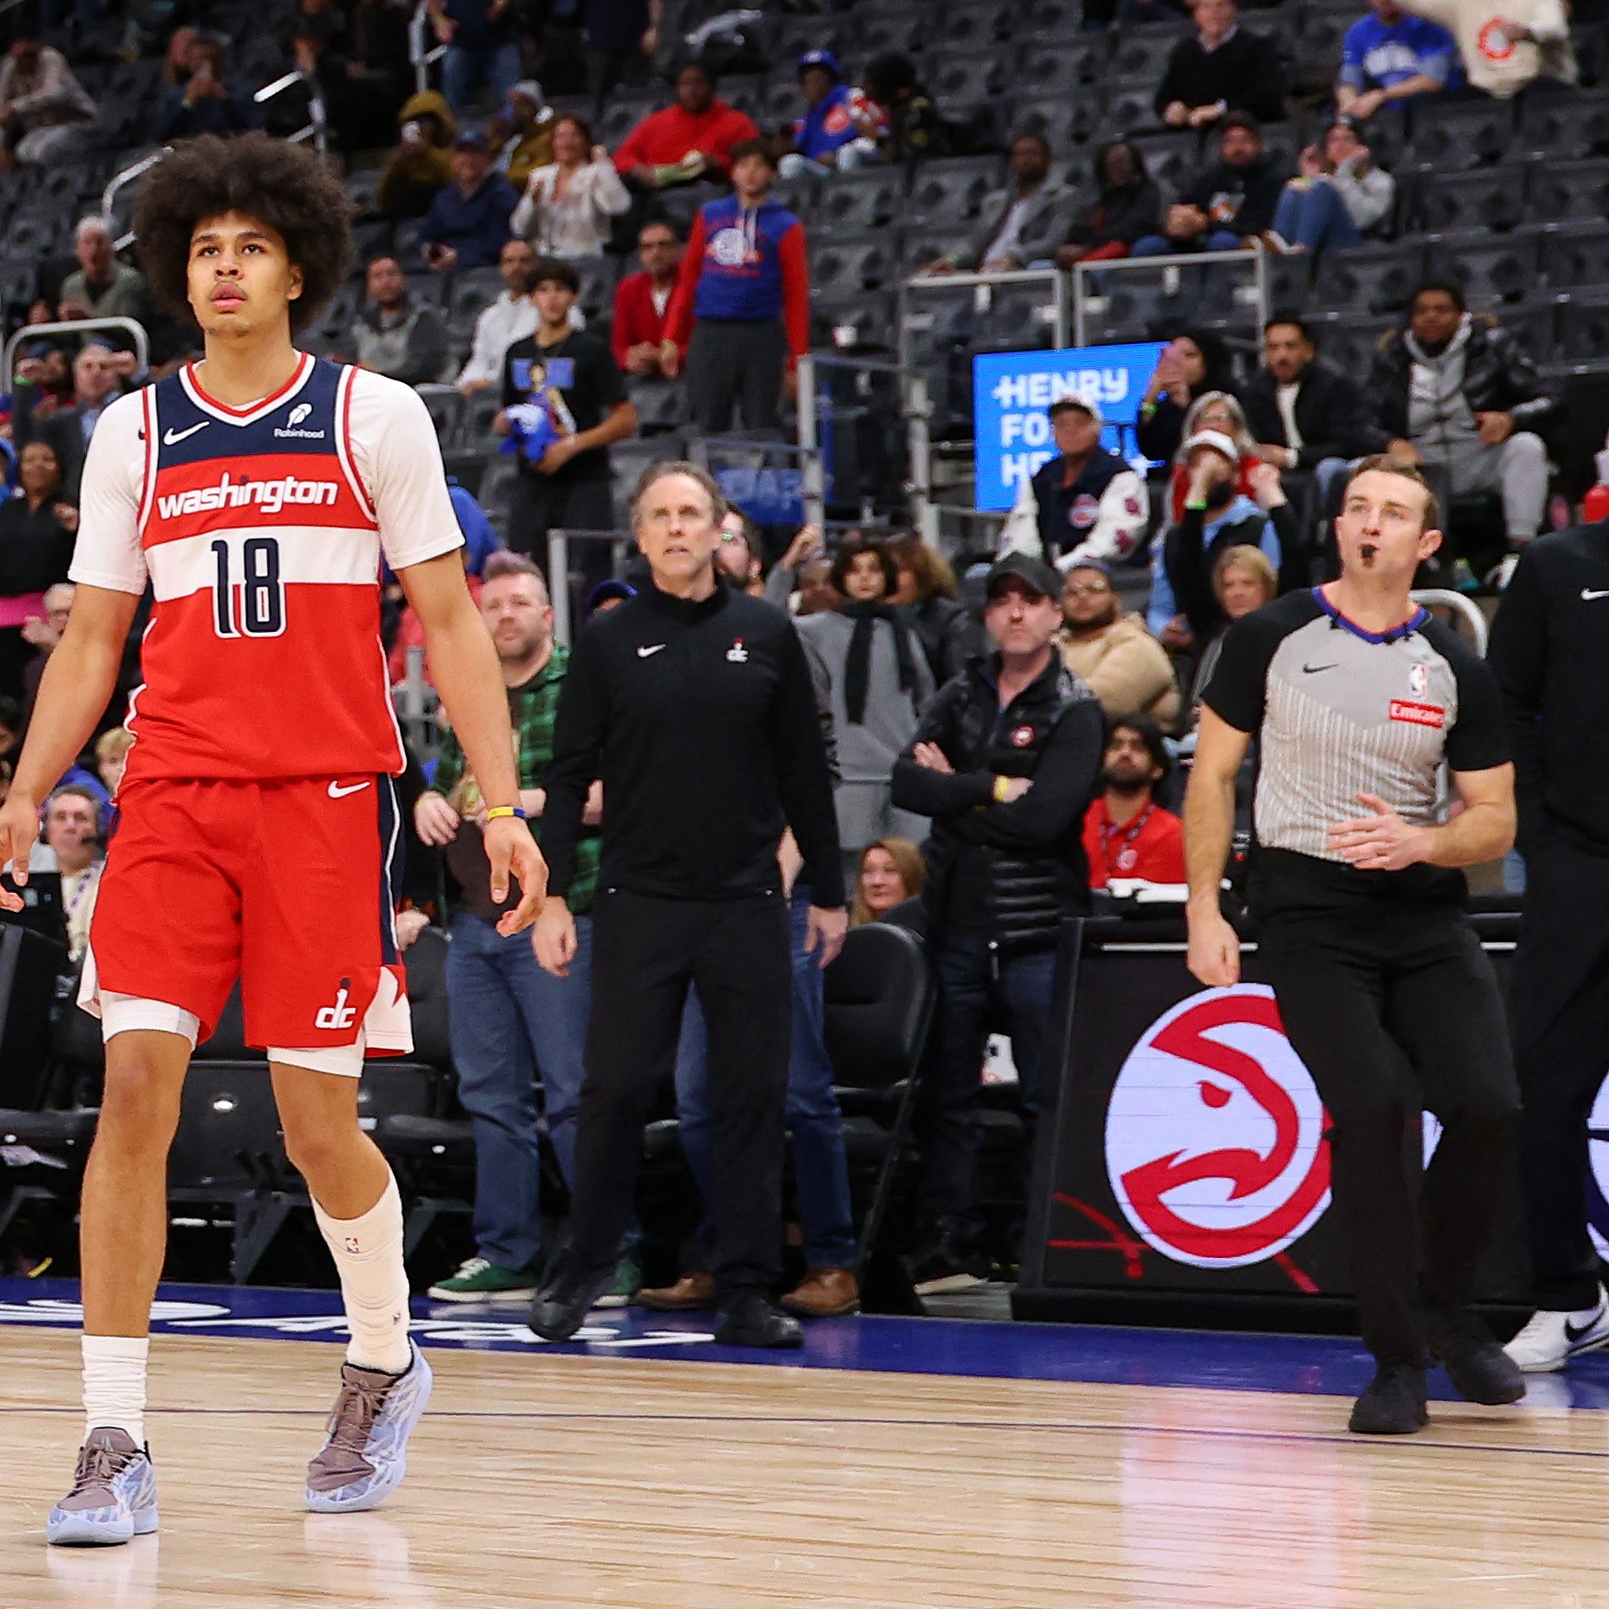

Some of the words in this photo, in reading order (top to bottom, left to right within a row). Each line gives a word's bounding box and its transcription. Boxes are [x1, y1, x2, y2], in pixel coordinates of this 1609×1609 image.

[992, 367, 1129, 409] HENRY
[274, 428, 325, 440] Robinhood
[158, 472, 339, 520] washington
[211, 538, 286, 638] 18
